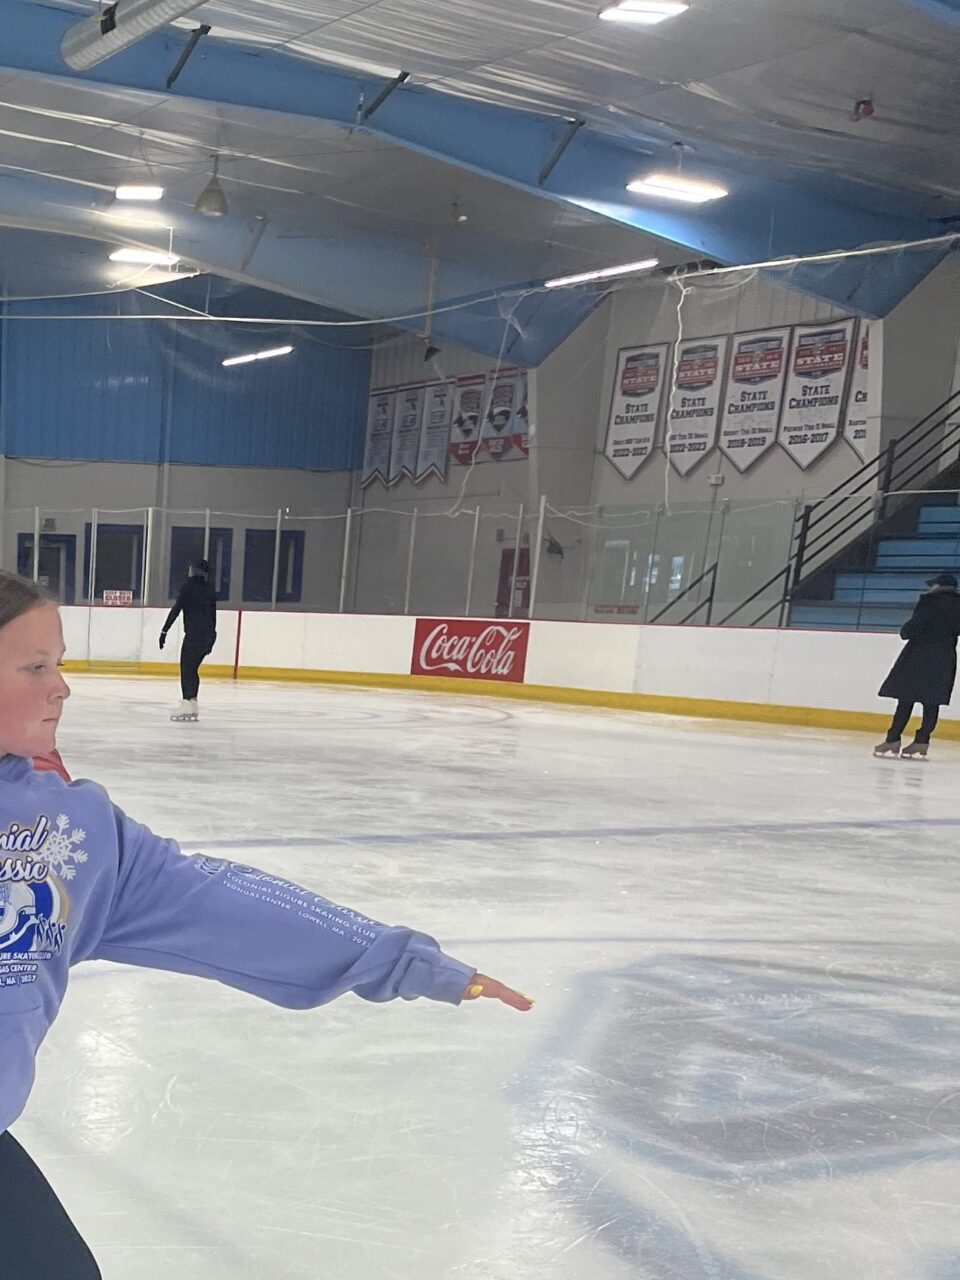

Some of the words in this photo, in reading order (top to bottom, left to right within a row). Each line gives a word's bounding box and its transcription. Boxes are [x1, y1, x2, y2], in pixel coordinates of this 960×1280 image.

[797, 353, 843, 365] STATE
[802, 384, 830, 396] STATE
[681, 397, 706, 408] STATE
[740, 391, 768, 402] STATE
[789, 395, 839, 409] CHAMPIONS
[625, 403, 648, 414] STATE
[671, 407, 714, 419] CHAMPIONS
[728, 401, 775, 414] CHAMPIONS
[226, 872, 273, 894] COLONIAL
[275, 890, 308, 908] FIGURE
[310, 905, 350, 928] SKATING
[352, 925, 376, 940] CLUB
[261, 895, 291, 911] CENTER
[10, 963, 37, 972] CENTER
